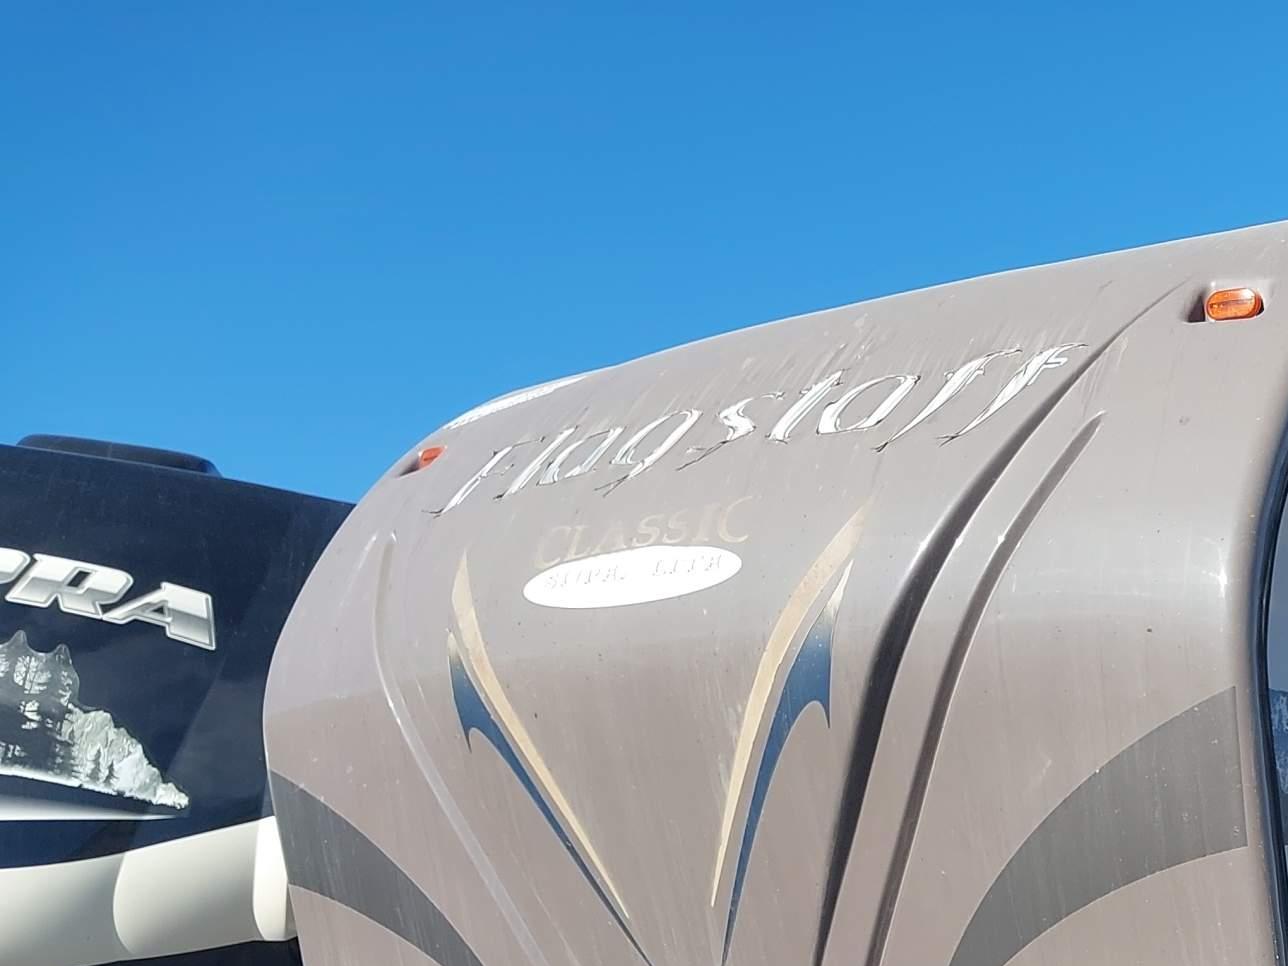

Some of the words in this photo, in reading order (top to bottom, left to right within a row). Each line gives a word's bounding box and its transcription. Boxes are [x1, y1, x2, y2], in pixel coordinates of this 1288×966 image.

[421, 342, 1088, 517] Flagstaff
[532, 495, 754, 568] CLASSIC
[0, 547, 216, 650] RA
